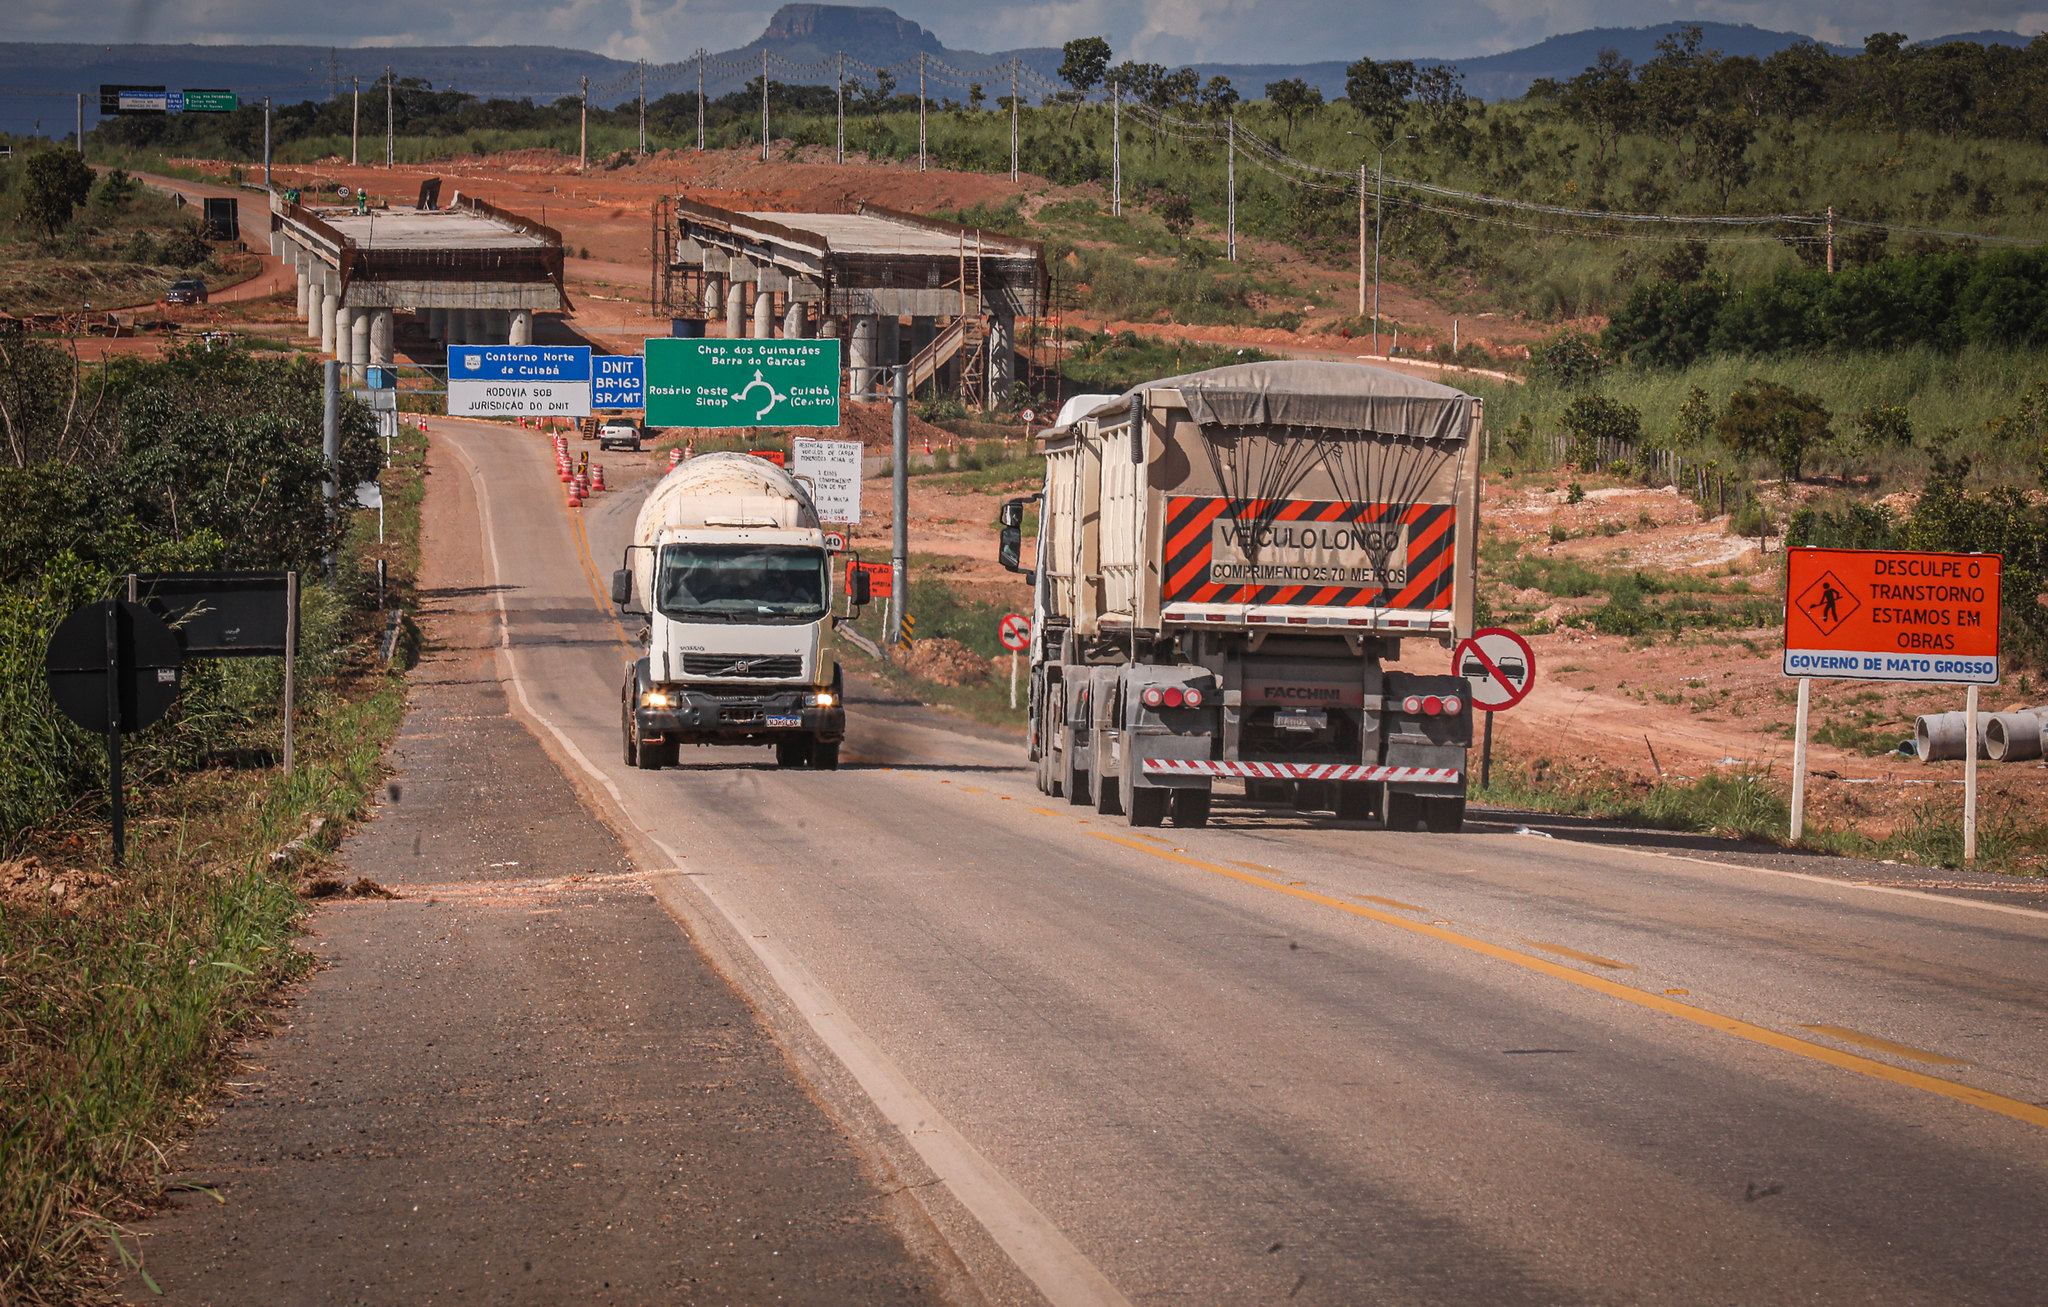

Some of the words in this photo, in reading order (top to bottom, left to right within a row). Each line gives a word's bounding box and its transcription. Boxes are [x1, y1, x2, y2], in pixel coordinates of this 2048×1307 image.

[698, 346, 728, 355] Chap.
[734, 346, 752, 355] dos
[486, 352, 537, 362] Contorno
[544, 352, 574, 362] Norte
[712, 357, 742, 365] Barra
[501, 366, 514, 374] de
[519, 365, 560, 375] Cuiabá
[602, 361, 634, 374] DNIT
[596, 378, 640, 388] BR-163
[487, 388, 526, 397] RODOVIA
[533, 388, 552, 397] SOB
[650, 385, 691, 395] Rosário
[697, 386, 728, 396] Oeste
[790, 385, 830, 396] Cuiabá
[595, 392, 641, 404] SR/MT
[696, 398, 728, 408] Sinop
[790, 397, 835, 407] (Centro)
[530, 402, 543, 410] DO
[549, 402, 569, 410] DNIT
[1322, 528, 1399, 552] LONGO
[1213, 564, 1310, 580] COMPRIMENTO
[1313, 568, 1344, 581] 25.70
[1351, 568, 1405, 583] METROS
[1875, 560, 1961, 578] DESCULPE
[1968, 562, 1980, 578] O
[1870, 584, 1984, 602] TRANSTORNO
[1872, 608, 1950, 625] ESTAMOS
[1958, 611, 1980, 626] EM
[1897, 632, 1955, 649] OBRAS
[1790, 656, 1858, 670] GOVERNO
[1864, 658, 1881, 670] DE
[1887, 659, 1930, 672] MATO
[1935, 660, 1993, 674] GROSSO
[1264, 686, 1341, 701] FACCHINI
